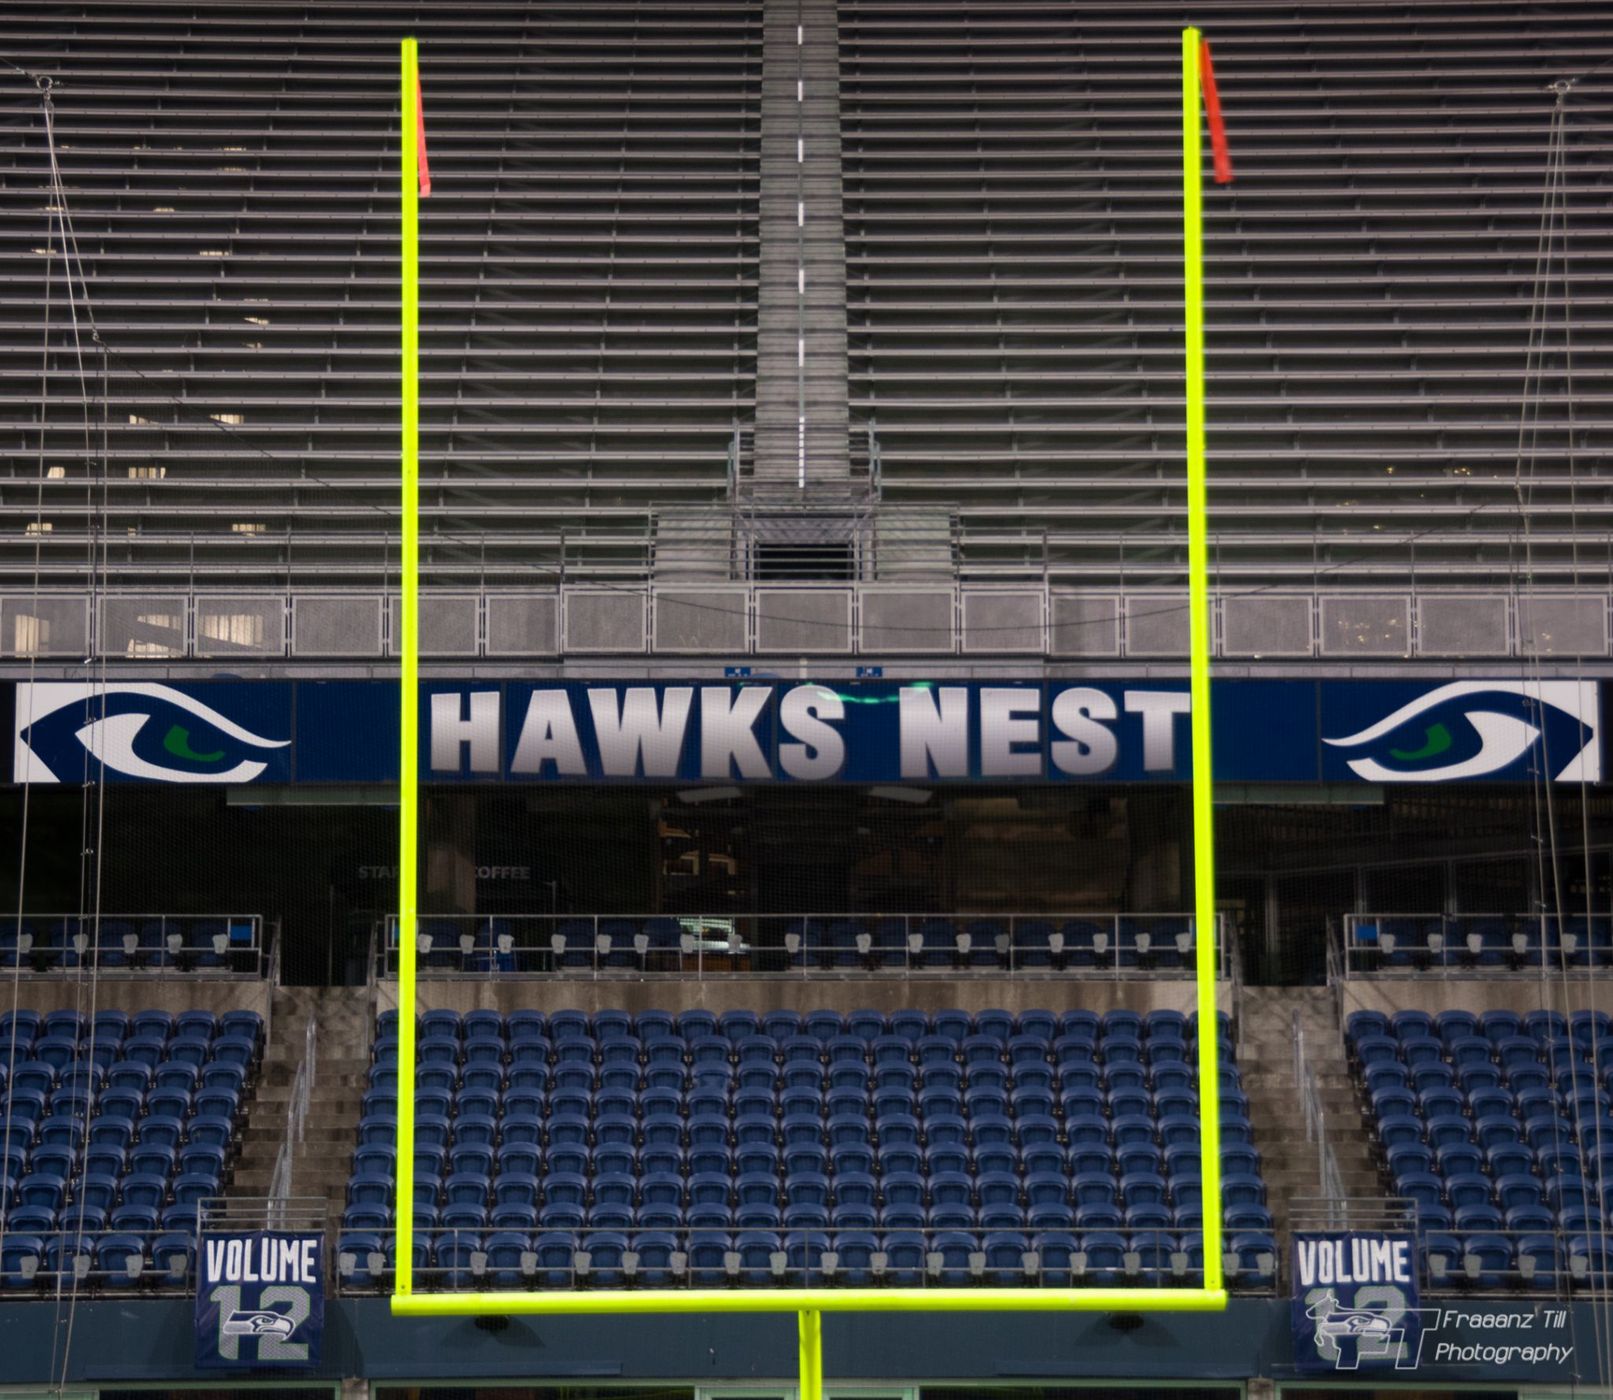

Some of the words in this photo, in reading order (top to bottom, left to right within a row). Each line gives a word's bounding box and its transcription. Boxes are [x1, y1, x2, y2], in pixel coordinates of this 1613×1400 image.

[431, 685, 845, 780] HAWKS
[899, 687, 1191, 778] NEST
[475, 866, 530, 878] OFFEE
[207, 1238, 317, 1283] VOLUME
[1298, 1238, 1411, 1285] VOLUME
[210, 1285, 310, 1360] 12
[1305, 1286, 1409, 1361] 12
